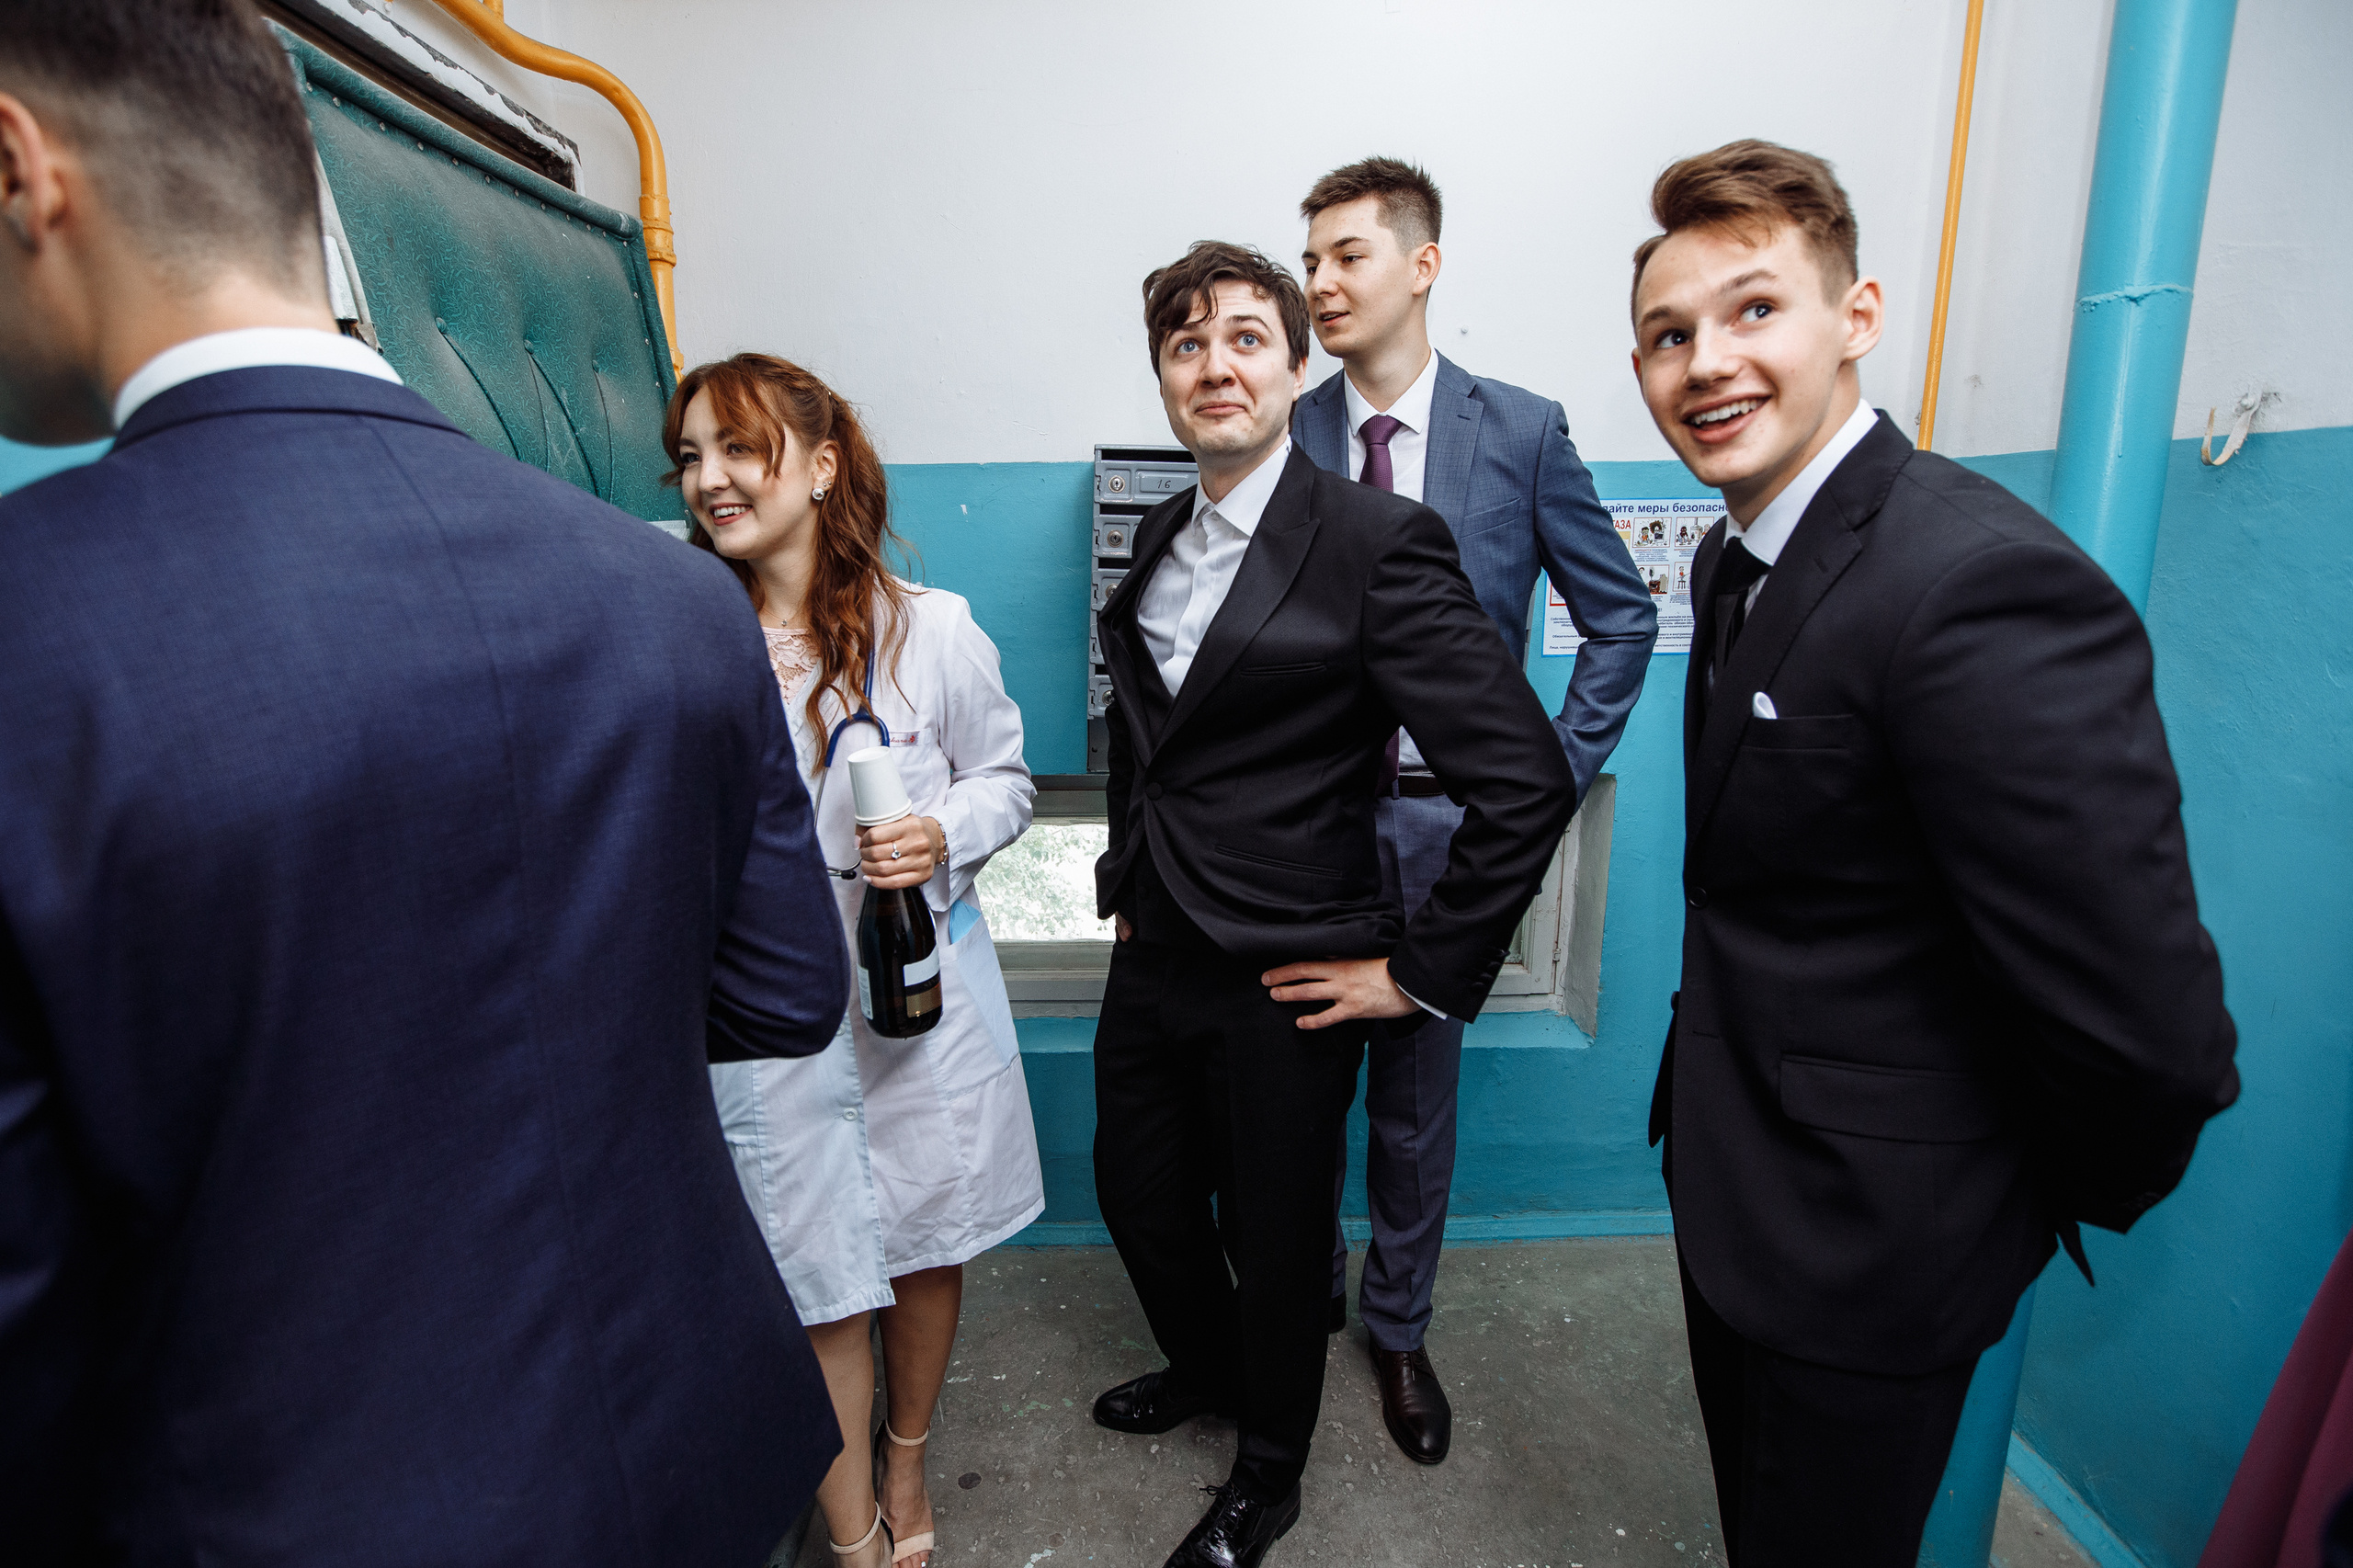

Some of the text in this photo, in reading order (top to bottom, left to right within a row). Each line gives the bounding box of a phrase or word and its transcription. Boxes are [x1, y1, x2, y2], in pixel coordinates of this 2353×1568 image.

[1157, 479, 1171, 489] 16
[1637, 505, 1669, 515] меры
[1612, 519, 1631, 529] АЗА
